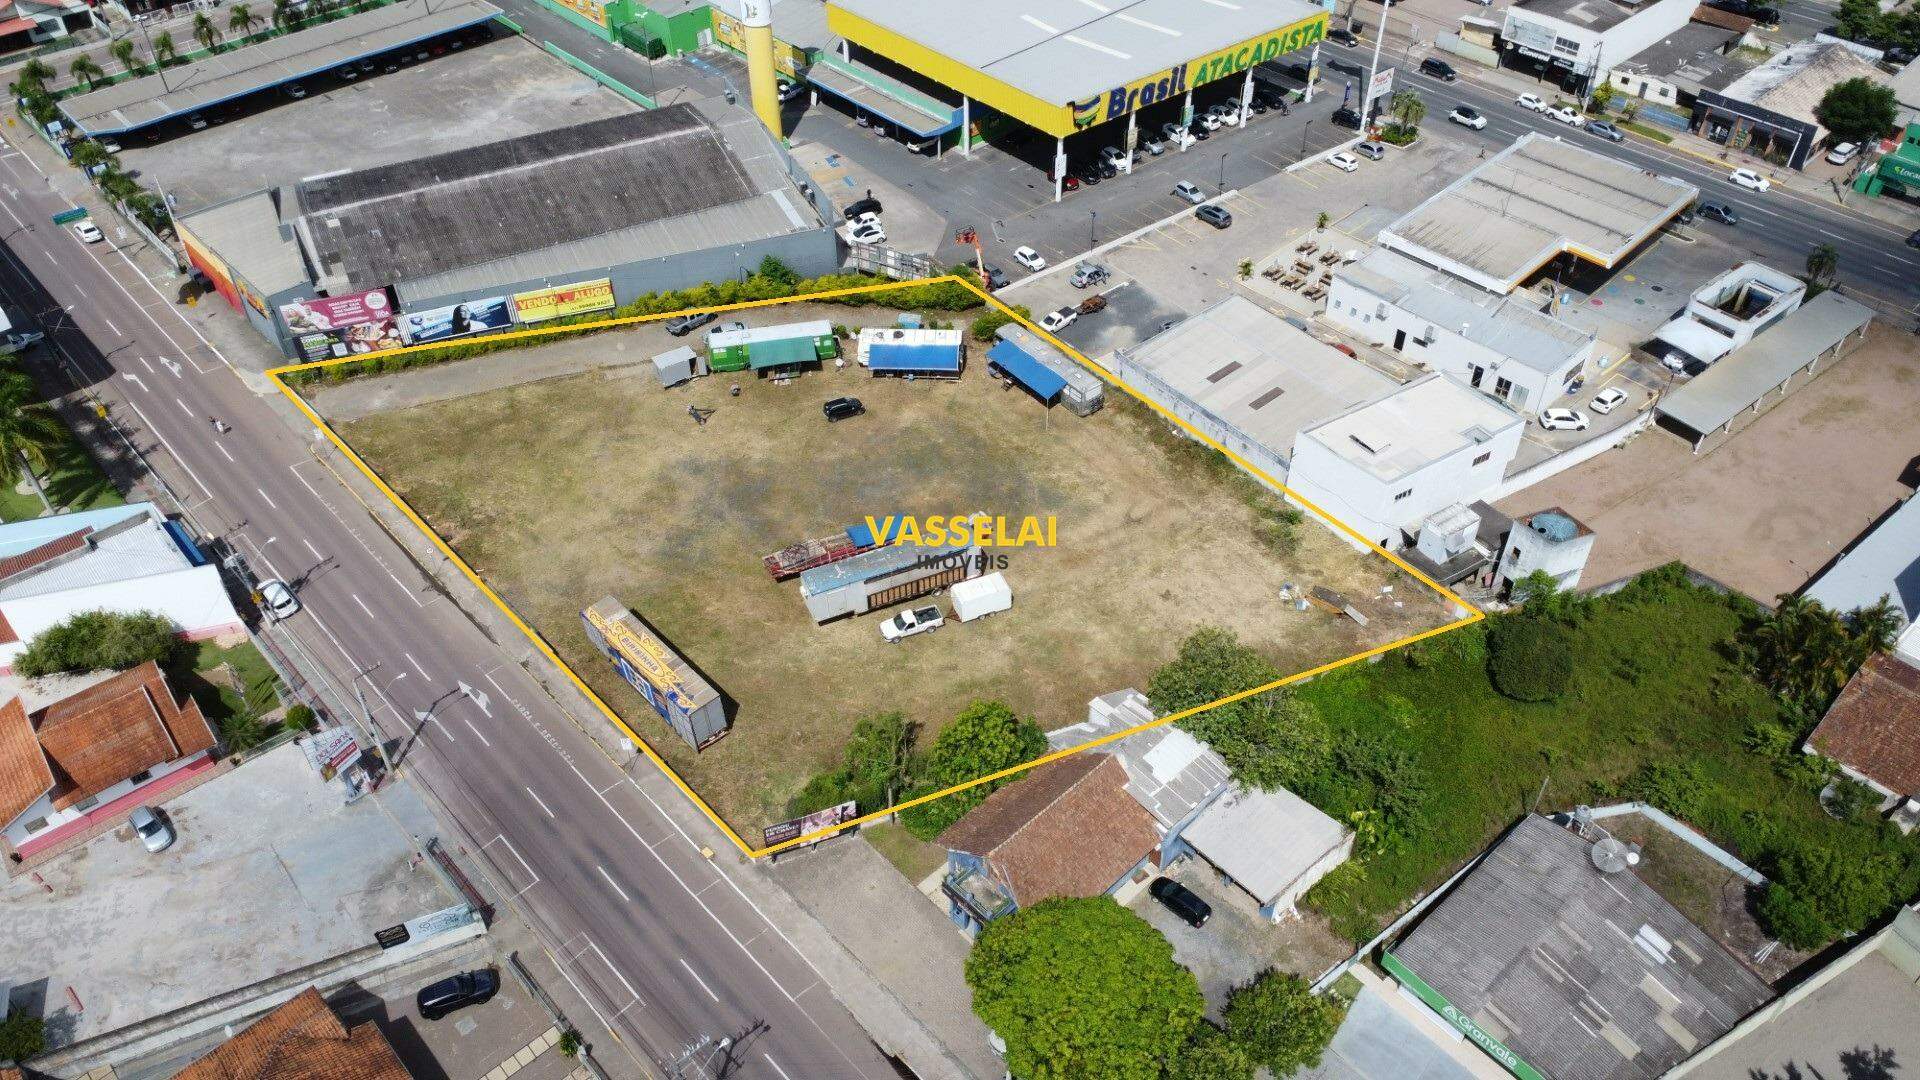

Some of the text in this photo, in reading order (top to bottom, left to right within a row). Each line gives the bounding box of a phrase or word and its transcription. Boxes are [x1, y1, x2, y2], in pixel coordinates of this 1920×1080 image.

[1107, 20, 1324, 119] Brasil ATACADISTA
[518, 294, 557, 311] VENDO
[573, 286, 610, 300] ALUGO
[1459, 1016, 1517, 1067] Granvale
